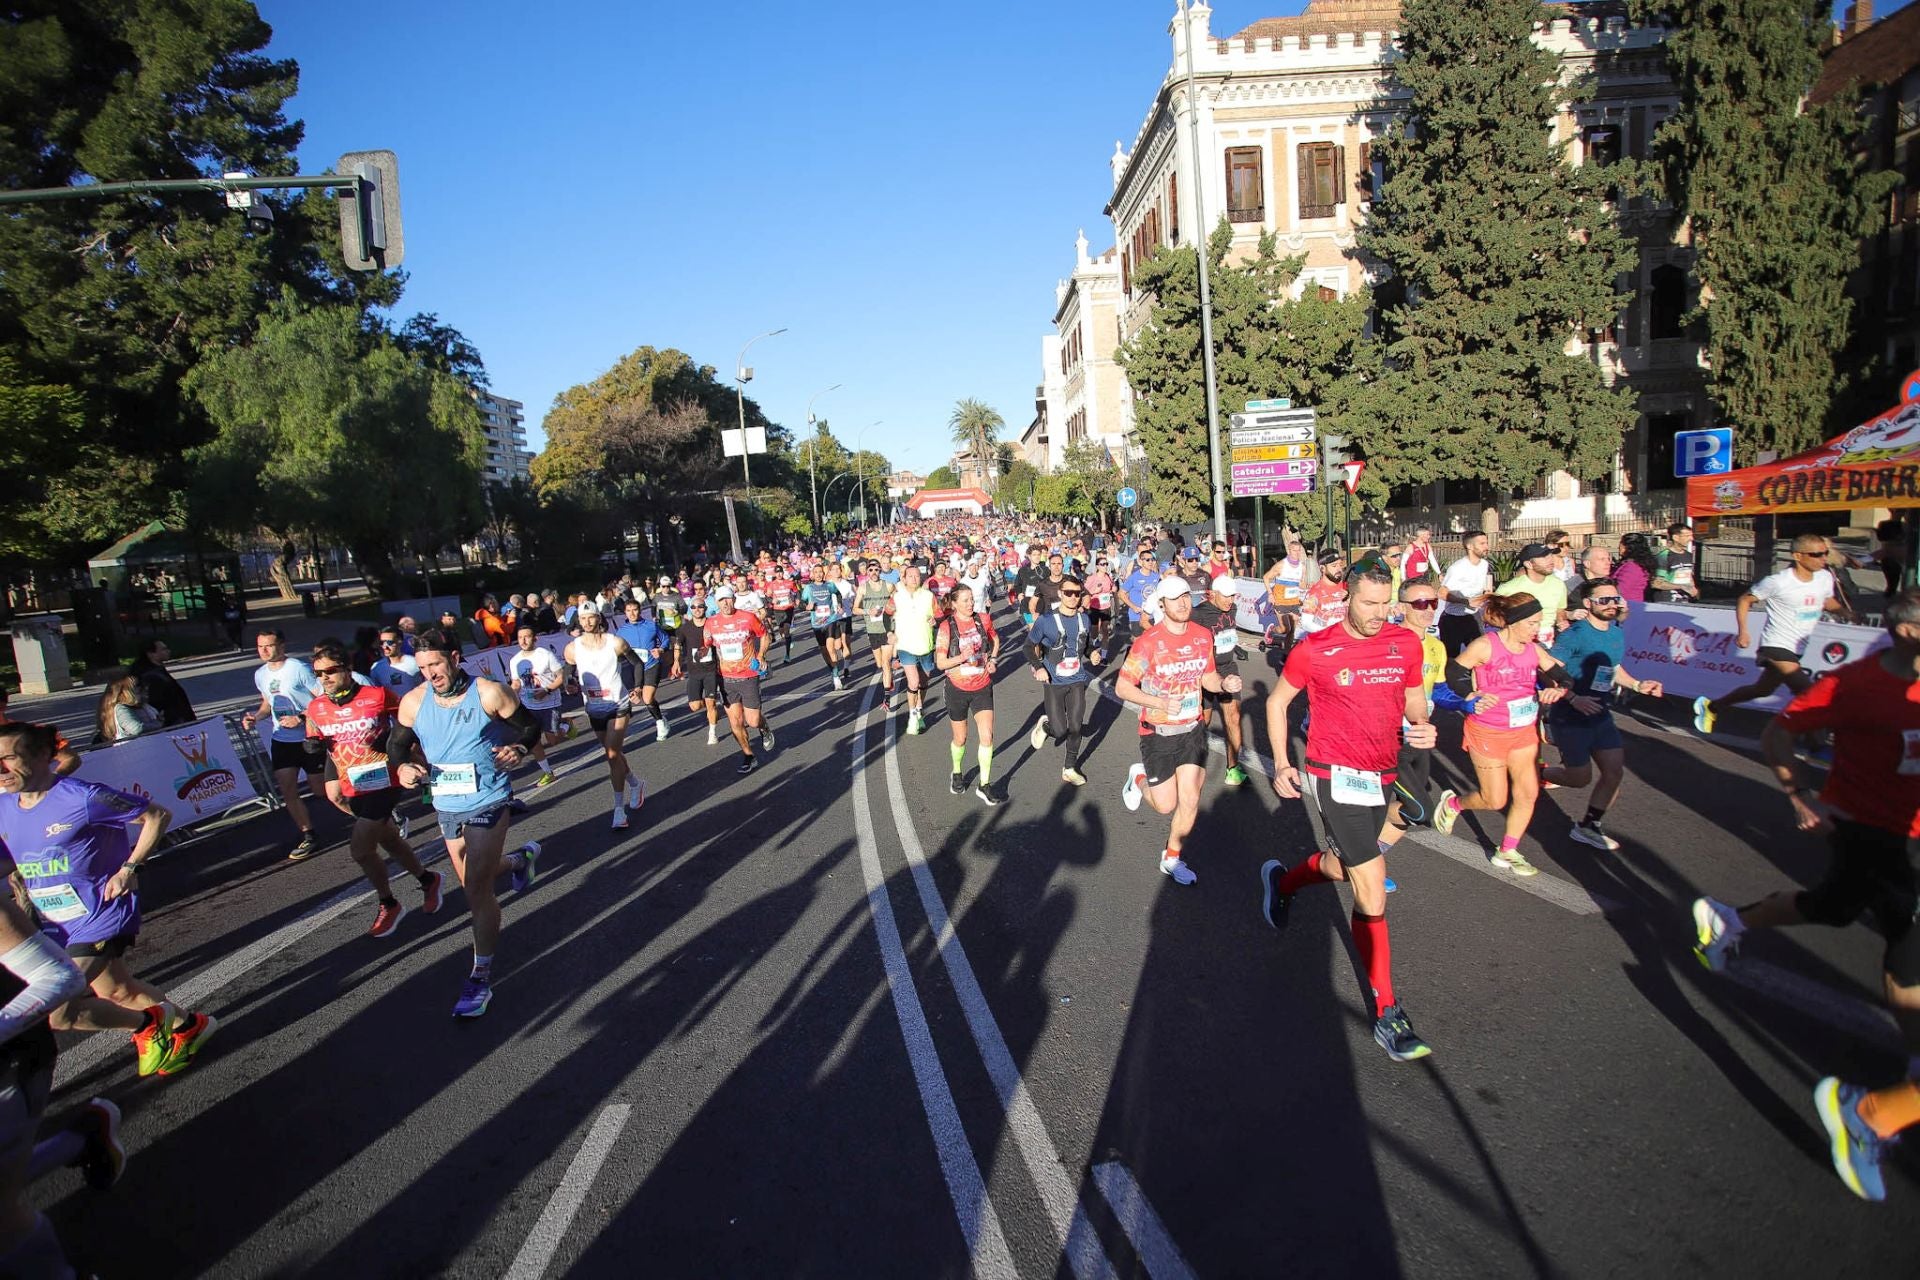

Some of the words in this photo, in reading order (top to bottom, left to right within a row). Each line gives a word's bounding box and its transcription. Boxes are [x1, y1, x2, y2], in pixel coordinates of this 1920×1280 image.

[1261, 434, 1294, 442] Nacional
[1685, 435, 1721, 472] P
[1234, 465, 1275, 476] catedral
[1357, 667, 1405, 676] PUERTAS
[1363, 676, 1402, 684] LORCA
[443, 773, 462, 781] 5221
[194, 774, 233, 793] MURCIA
